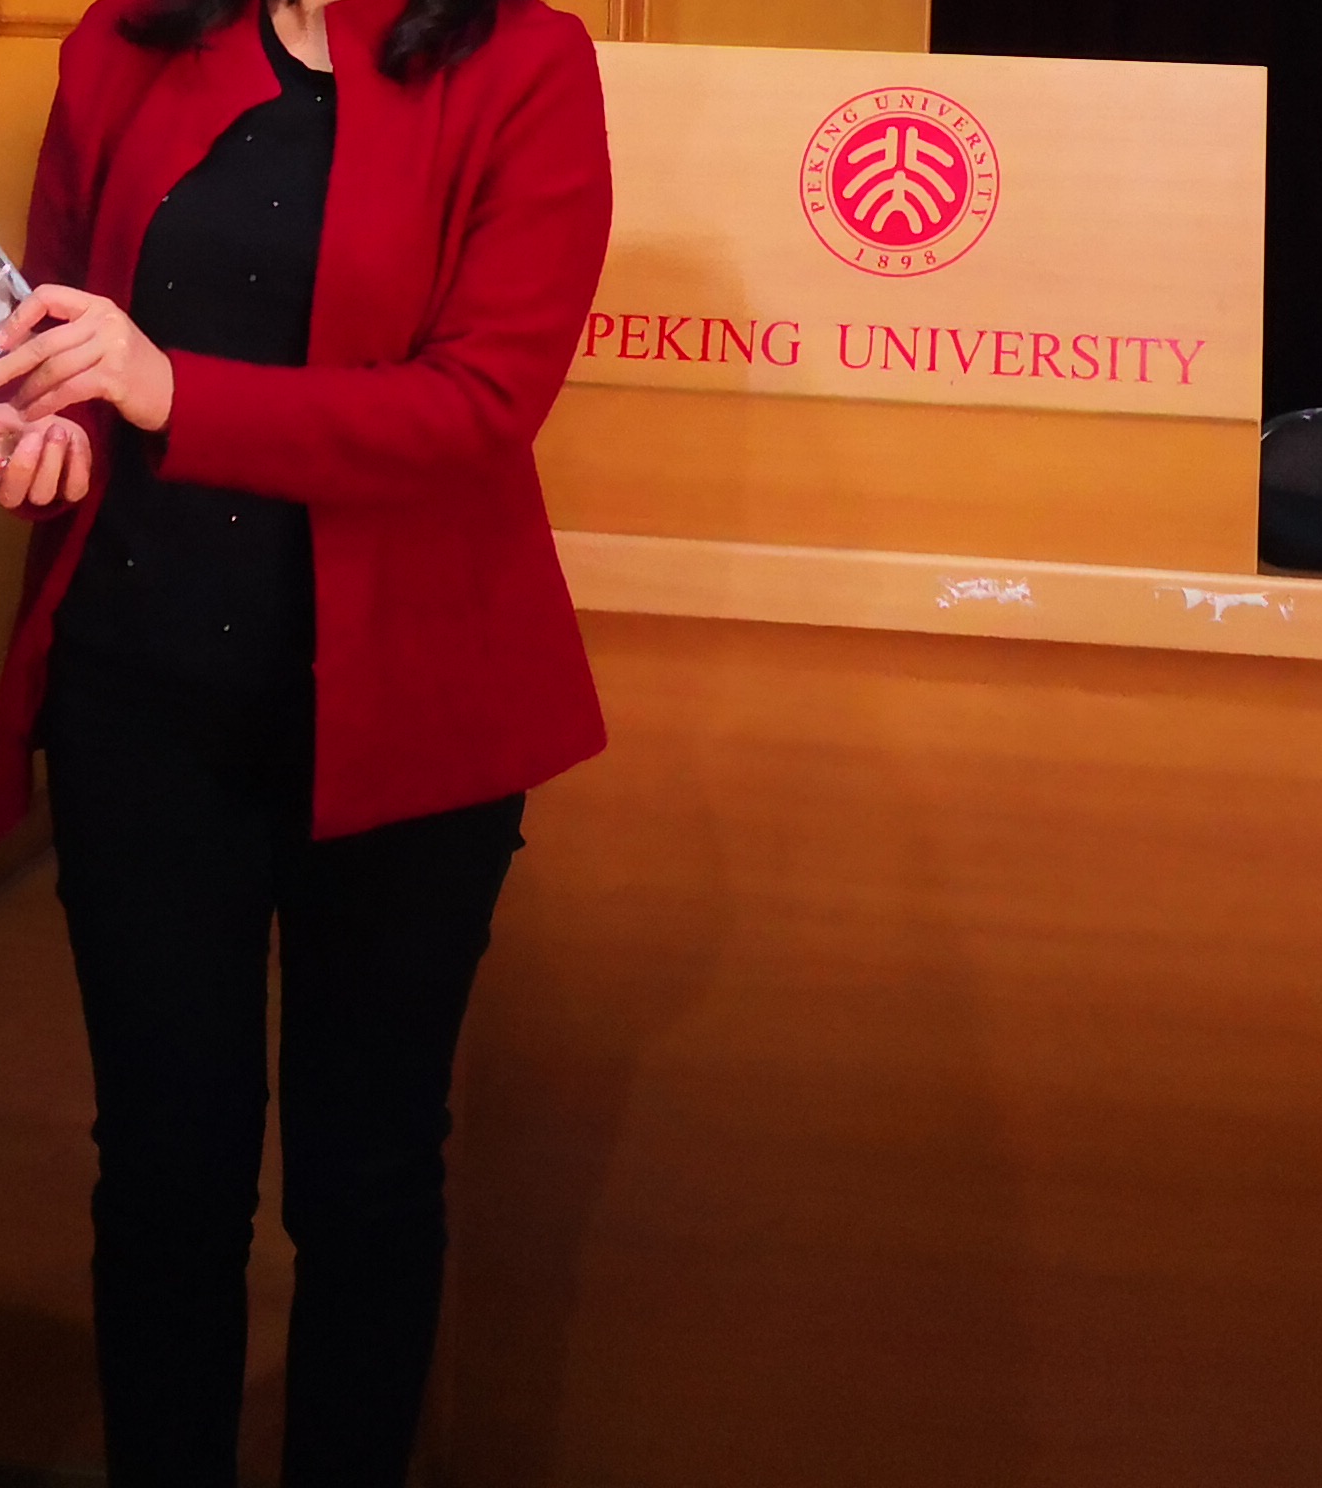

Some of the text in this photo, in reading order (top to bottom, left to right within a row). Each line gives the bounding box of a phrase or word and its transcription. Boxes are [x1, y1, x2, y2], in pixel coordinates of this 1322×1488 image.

[808, 94, 993, 222] PEKING UNIVERSITY
[854, 248, 937, 270] 1898
[582, 312, 1209, 385] PEKING UNIVERSITY
